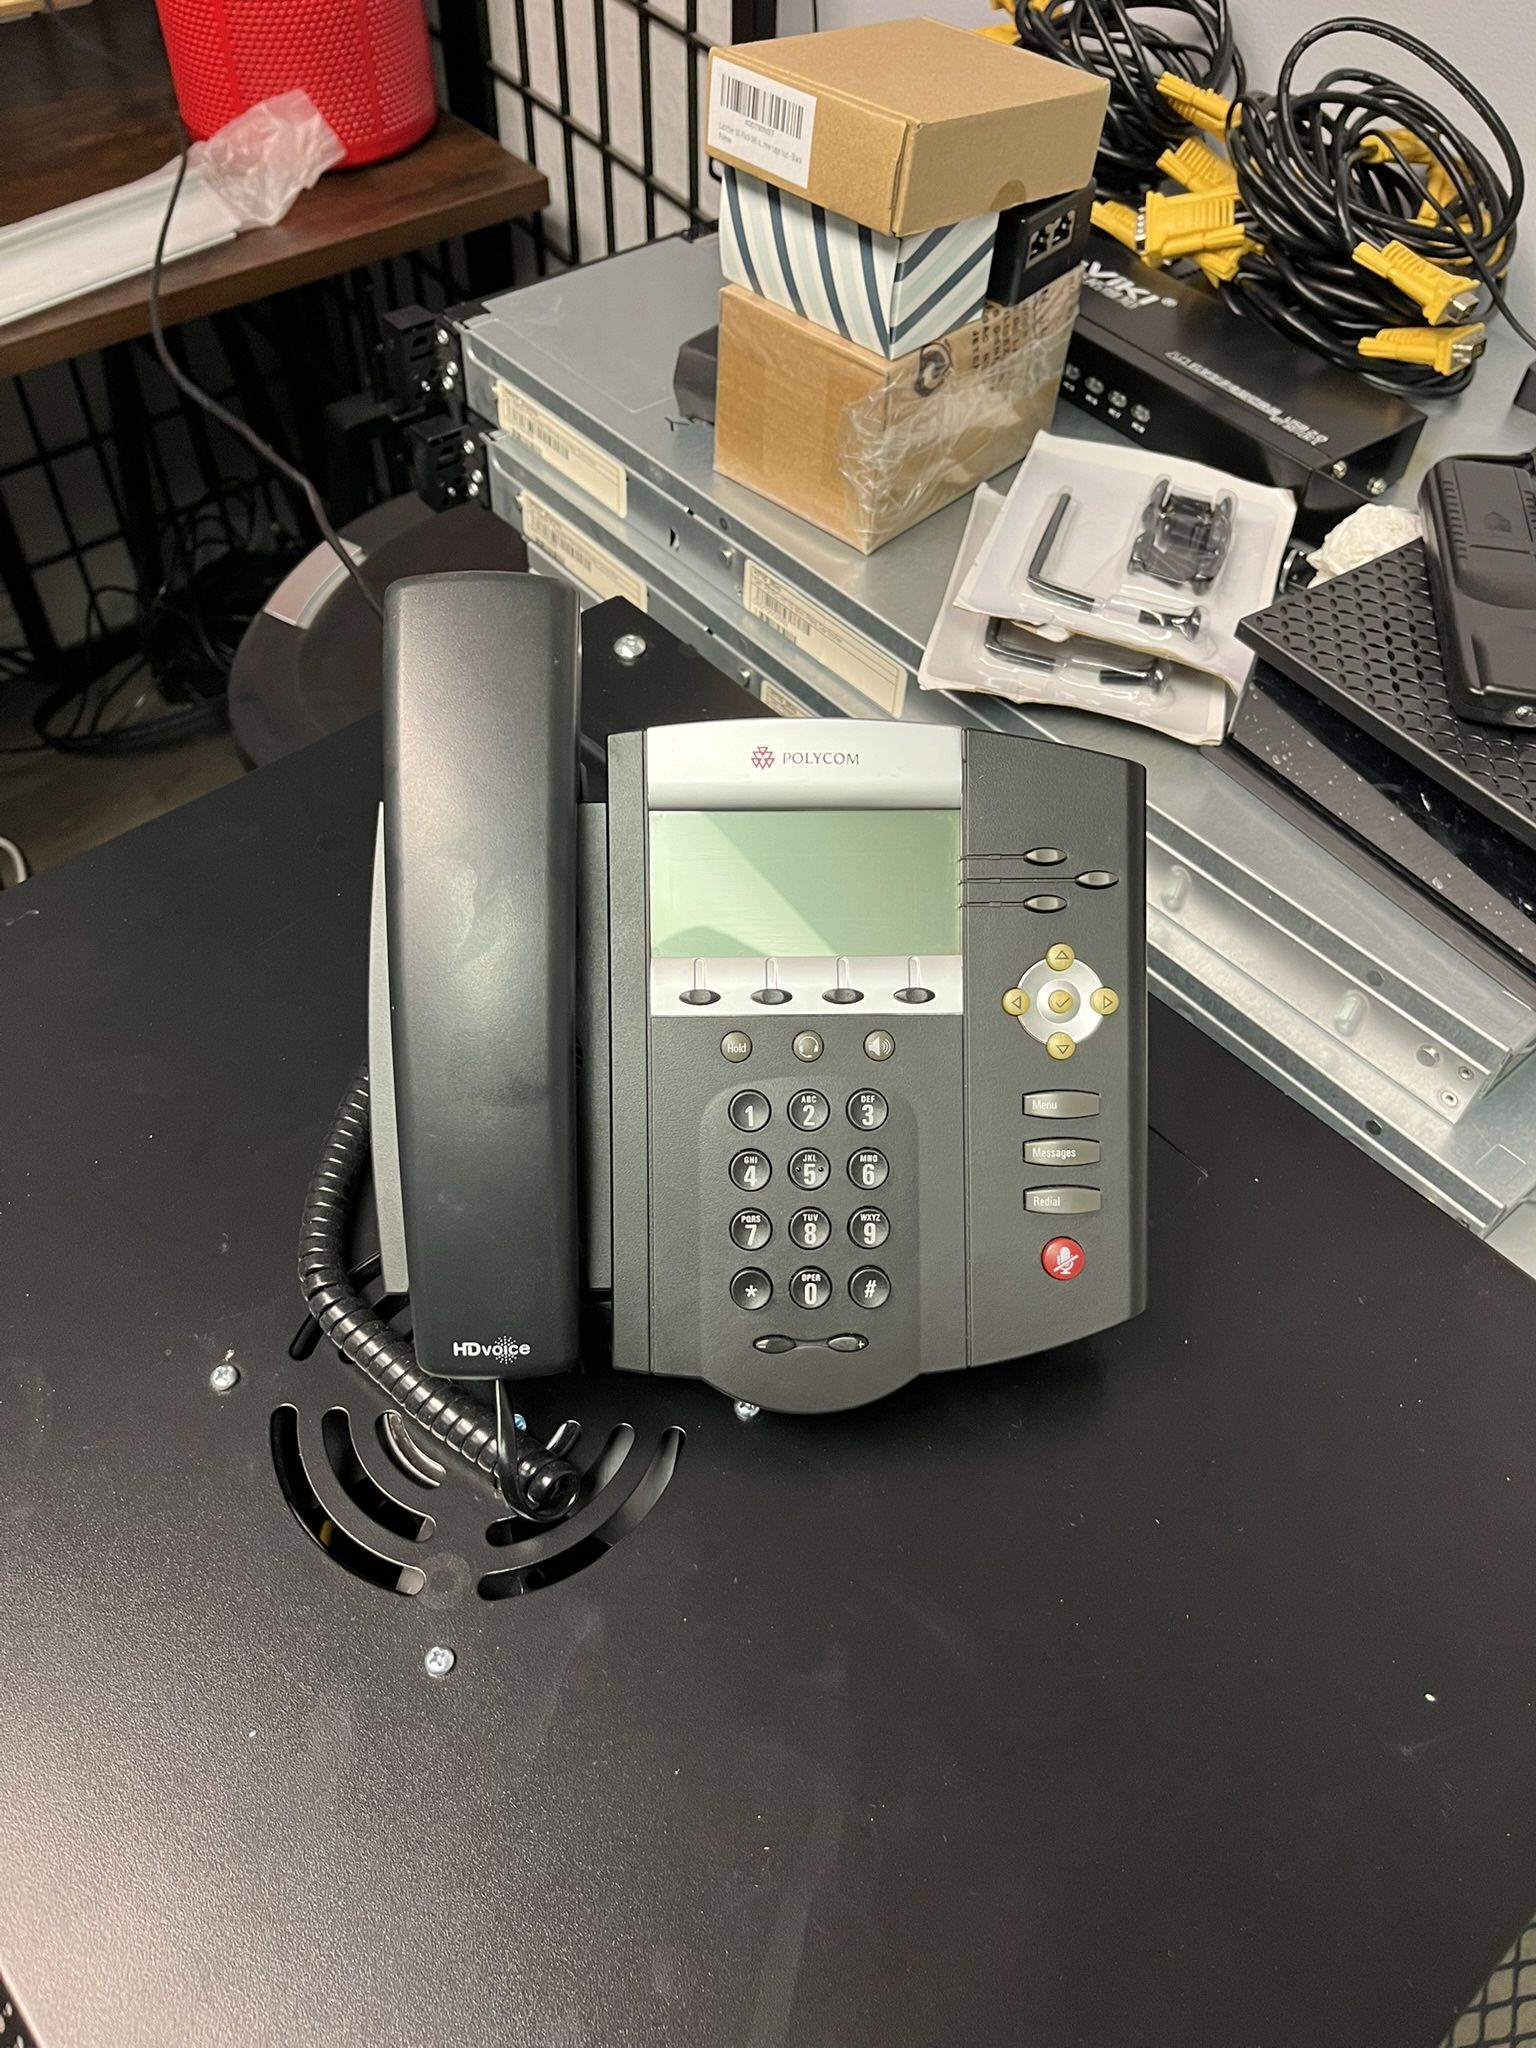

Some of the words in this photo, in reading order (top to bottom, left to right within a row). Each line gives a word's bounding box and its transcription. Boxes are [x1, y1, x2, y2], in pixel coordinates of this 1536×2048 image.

[782, 751, 860, 766] POLYCOM
[727, 1042, 747, 1054] Hold
[800, 1095, 817, 1104] ABC
[860, 1095, 876, 1103] DEF
[1031, 1099, 1058, 1111] Menu
[744, 1105, 754, 1127] 1
[802, 1104, 816, 1126] 2
[861, 1104, 874, 1126] 3
[743, 1156, 758, 1164] GHI
[802, 1154, 817, 1163] JKL
[859, 1154, 878, 1163] MNO
[1031, 1147, 1077, 1160] Messages
[743, 1165, 758, 1187] 4
[803, 1163, 816, 1185] 5
[862, 1163, 875, 1186] 6
[1033, 1196, 1061, 1207] Redial
[740, 1215, 761, 1223] PQRS
[802, 1213, 819, 1222] TUV
[860, 1213, 881, 1222] WXYZ
[744, 1224, 758, 1246] 7
[804, 1222, 817, 1245] 8
[863, 1222, 876, 1245] 9
[801, 1273, 821, 1282] OPER
[804, 1282, 818, 1305] 0
[864, 1279, 877, 1299] #
[452, 1340, 531, 1358] HDvoice
